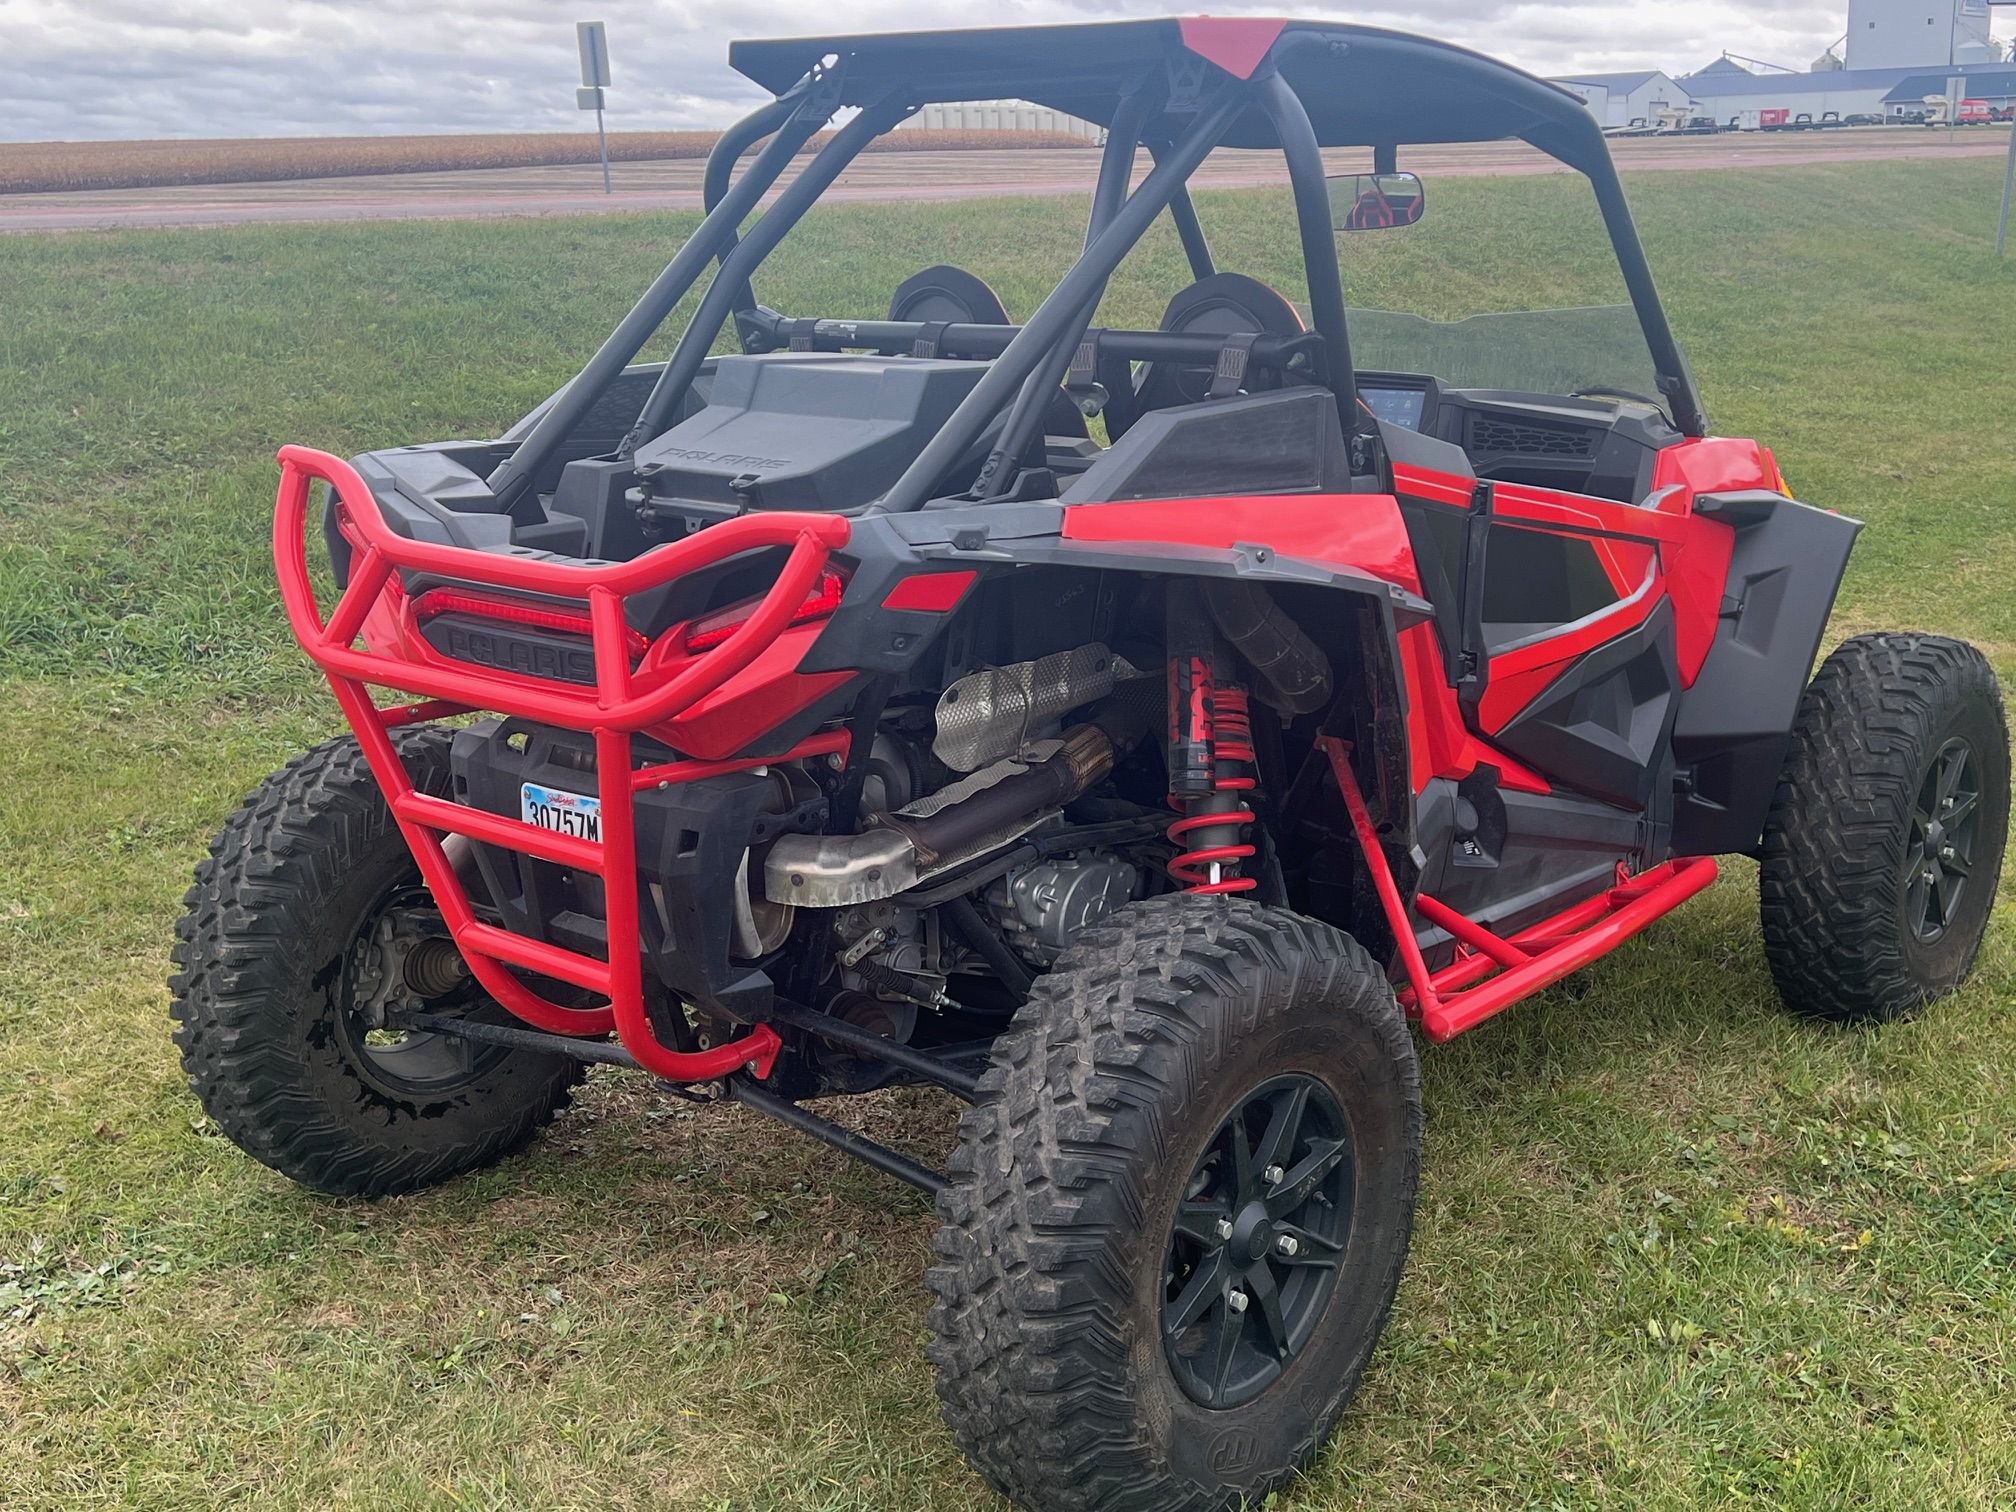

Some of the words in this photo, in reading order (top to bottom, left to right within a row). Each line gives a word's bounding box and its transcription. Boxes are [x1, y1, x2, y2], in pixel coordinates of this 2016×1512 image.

[656, 447, 792, 470] POLARIS
[449, 628, 596, 684] POLARIS
[529, 801, 598, 842] 30757M
[1213, 1435, 1259, 1472] ITP
